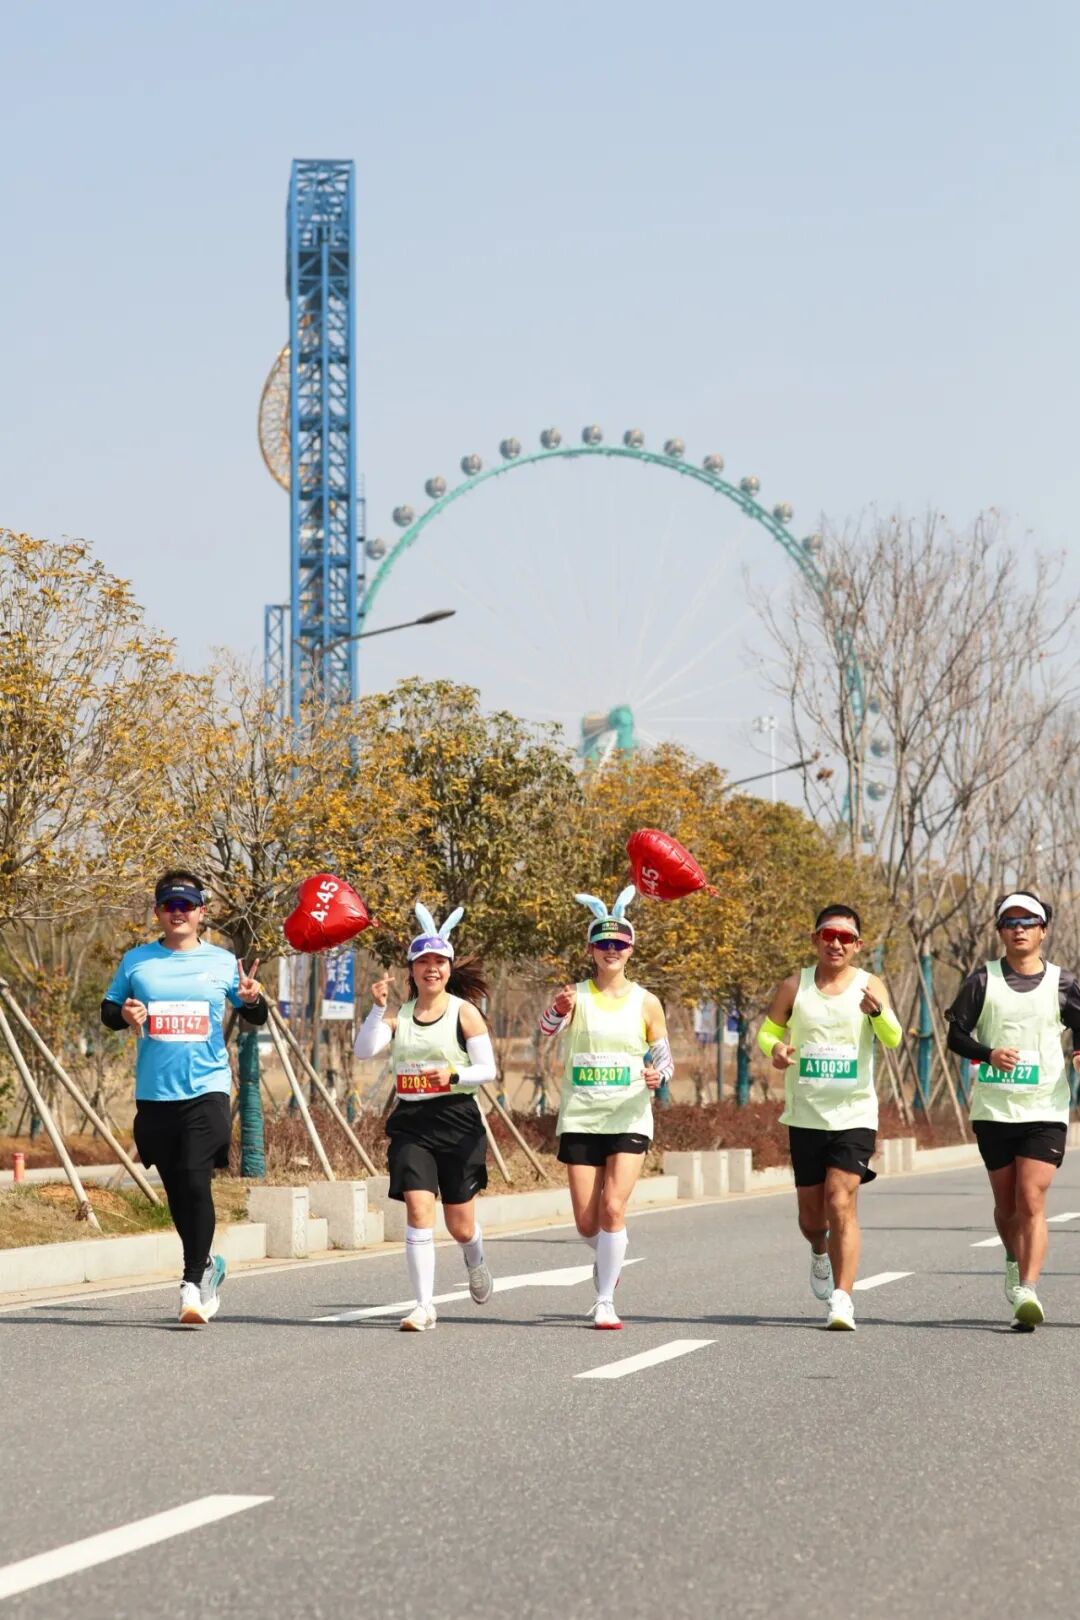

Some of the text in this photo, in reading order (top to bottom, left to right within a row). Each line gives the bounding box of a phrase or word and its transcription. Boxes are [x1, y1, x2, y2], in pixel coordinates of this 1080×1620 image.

[310, 881, 339, 922] 4:45
[155, 1016, 202, 1030] B10147
[805, 1060, 850, 1073] A10030
[579, 1068, 623, 1081] A20207
